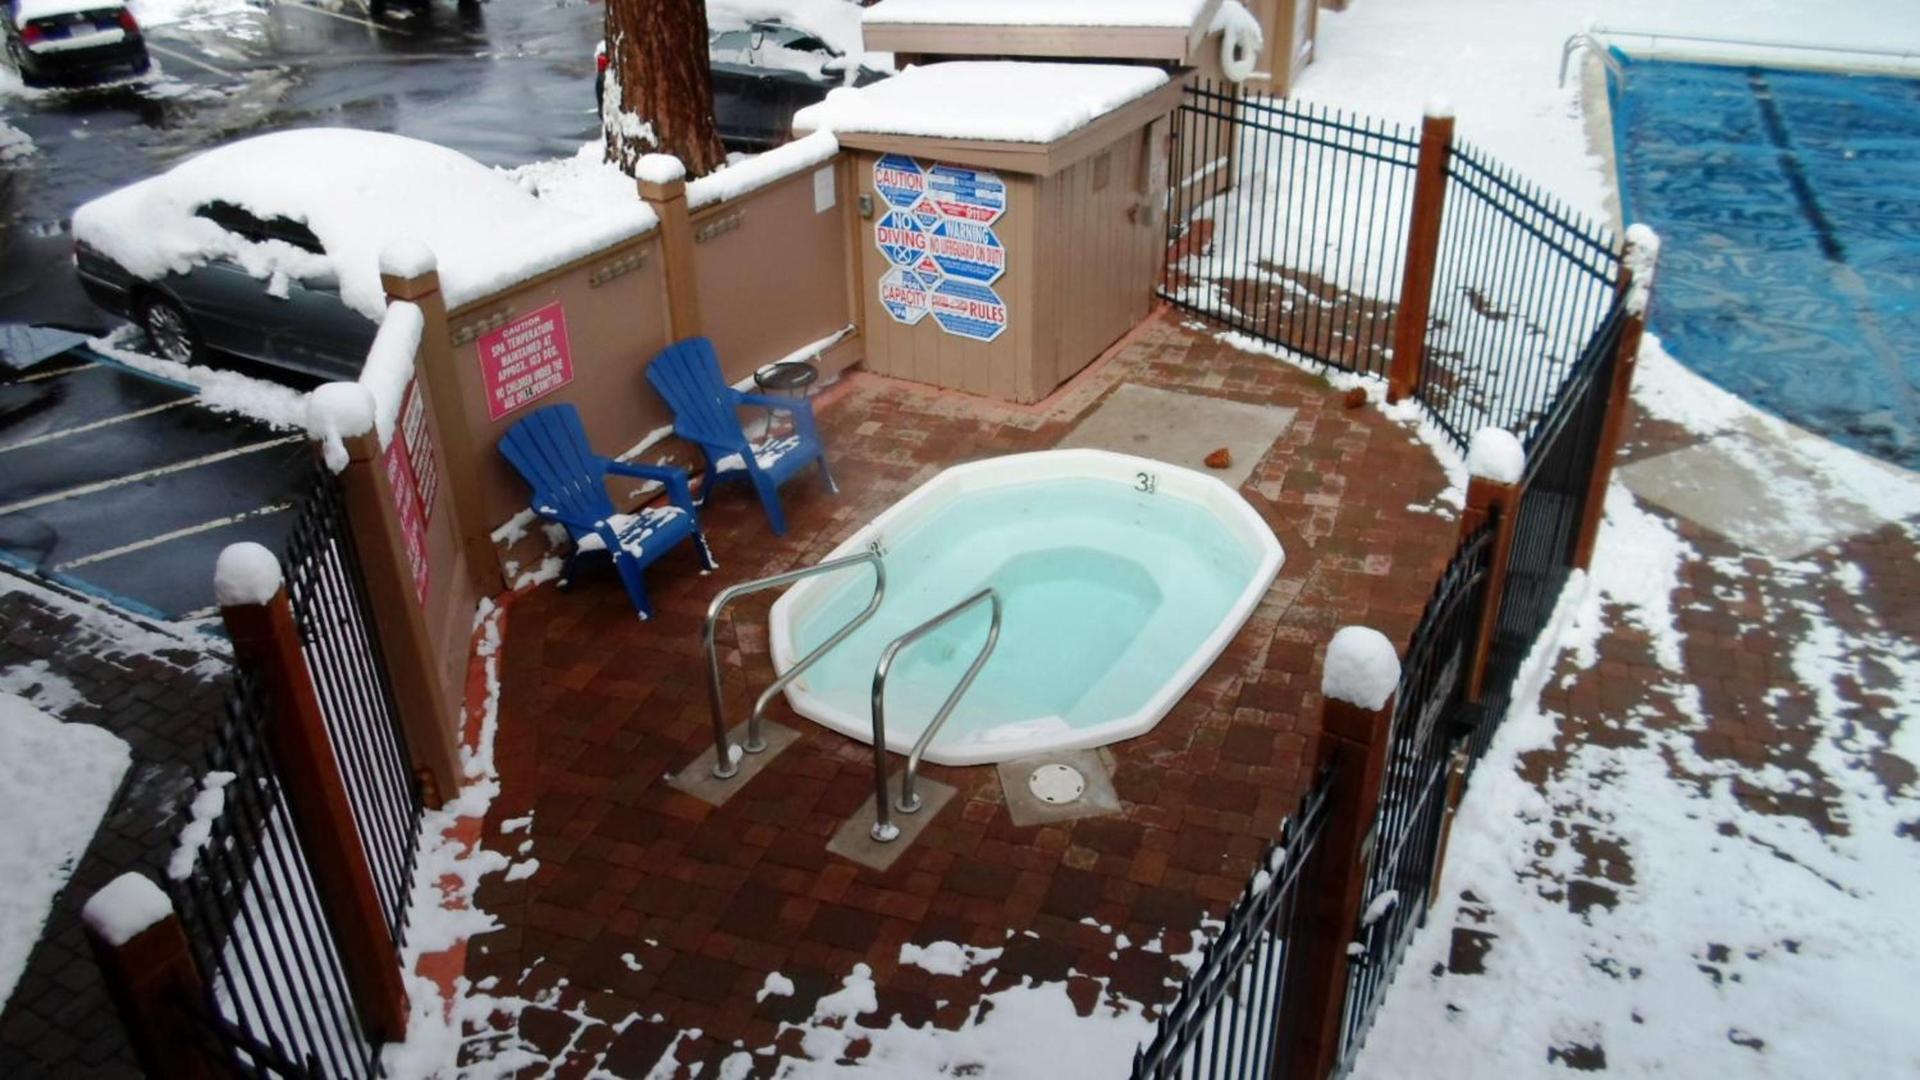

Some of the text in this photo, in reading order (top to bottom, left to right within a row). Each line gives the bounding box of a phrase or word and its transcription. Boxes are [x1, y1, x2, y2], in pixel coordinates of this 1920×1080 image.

[875, 168, 923, 192] CAUTION
[892, 211, 912, 230] NO
[878, 227, 926, 250] DIVING
[945, 220, 990, 245] WARNING
[929, 235, 1004, 267] NO LIFEGUARD ON DUTY
[881, 284, 927, 307] CAPACITY
[969, 302, 1005, 323] RULES
[502, 315, 541, 338] CAUTION
[491, 319, 555, 358] SPA TEMPERATURE
[543, 334, 552, 348] AT
[495, 386, 506, 402] NO
[505, 373, 533, 396] CHILDREN
